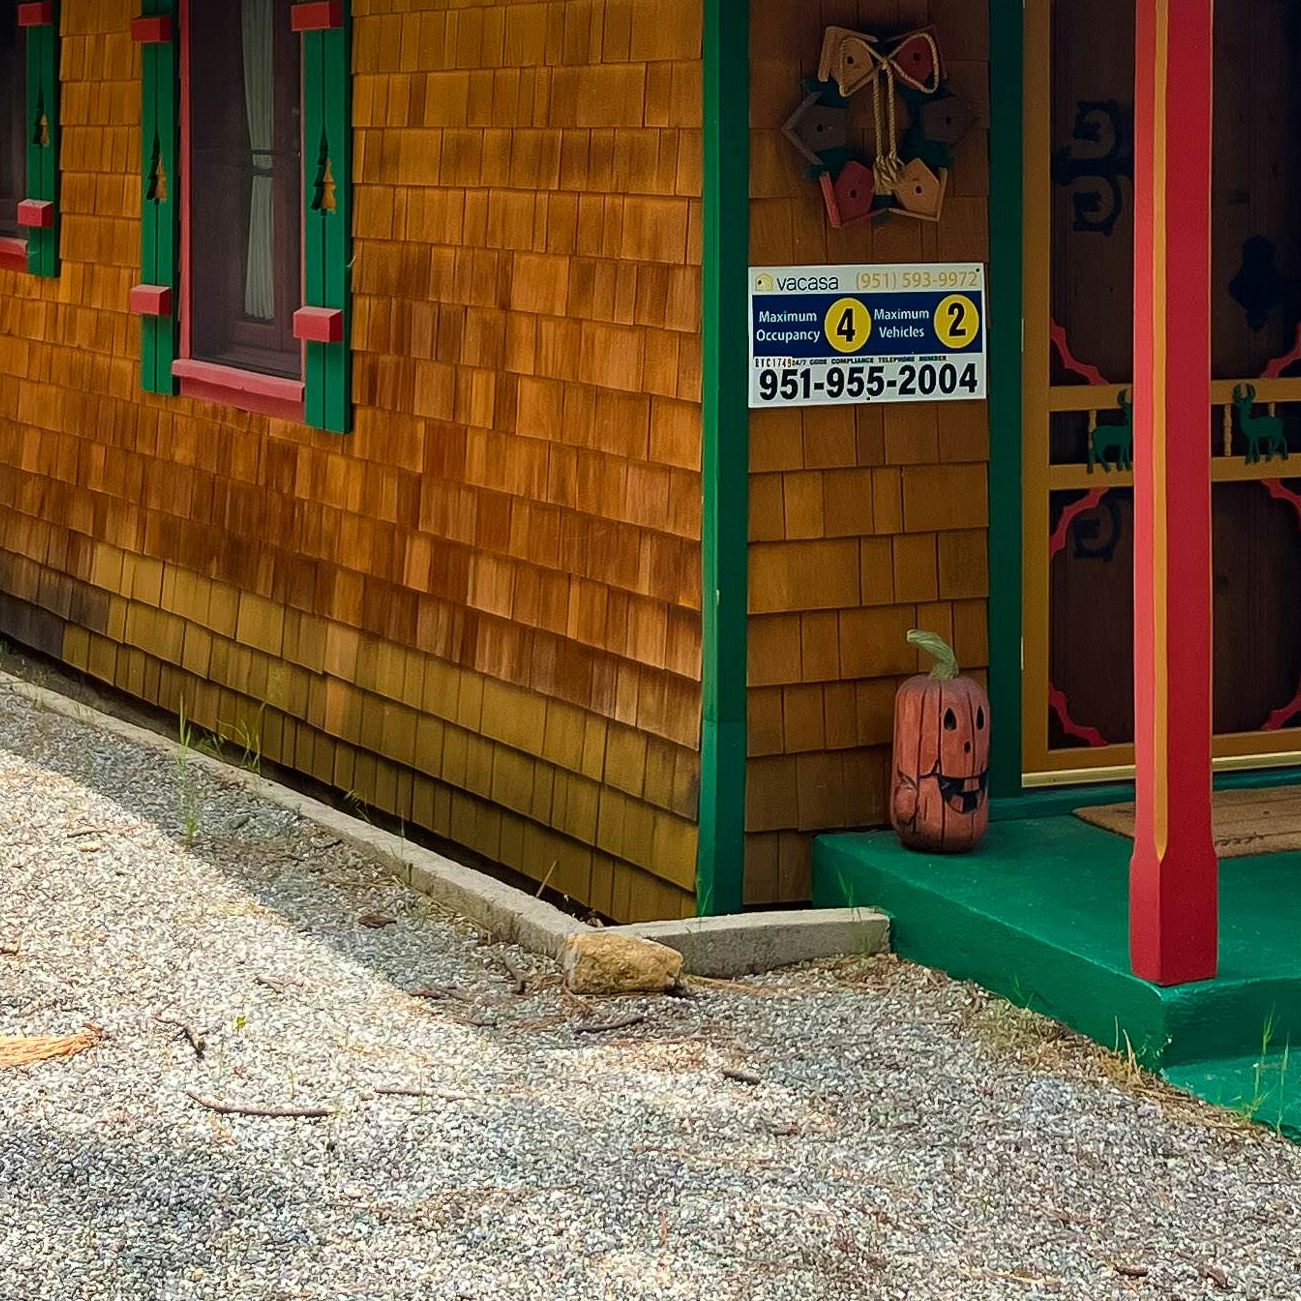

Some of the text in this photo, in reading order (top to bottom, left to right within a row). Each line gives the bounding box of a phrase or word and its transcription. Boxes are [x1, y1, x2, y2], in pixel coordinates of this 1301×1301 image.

[776, 276, 839, 291] vacasa
[856, 271, 978, 290] (951) 593-9972
[758, 310, 817, 323] Maximum
[874, 308, 930, 321] Maximum
[947, 302, 967, 337] 2
[837, 308, 856, 342] 4
[879, 325, 925, 339] Vehicles
[756, 328, 821, 343] Occupancy
[759, 363, 978, 401] 951-955-2004
